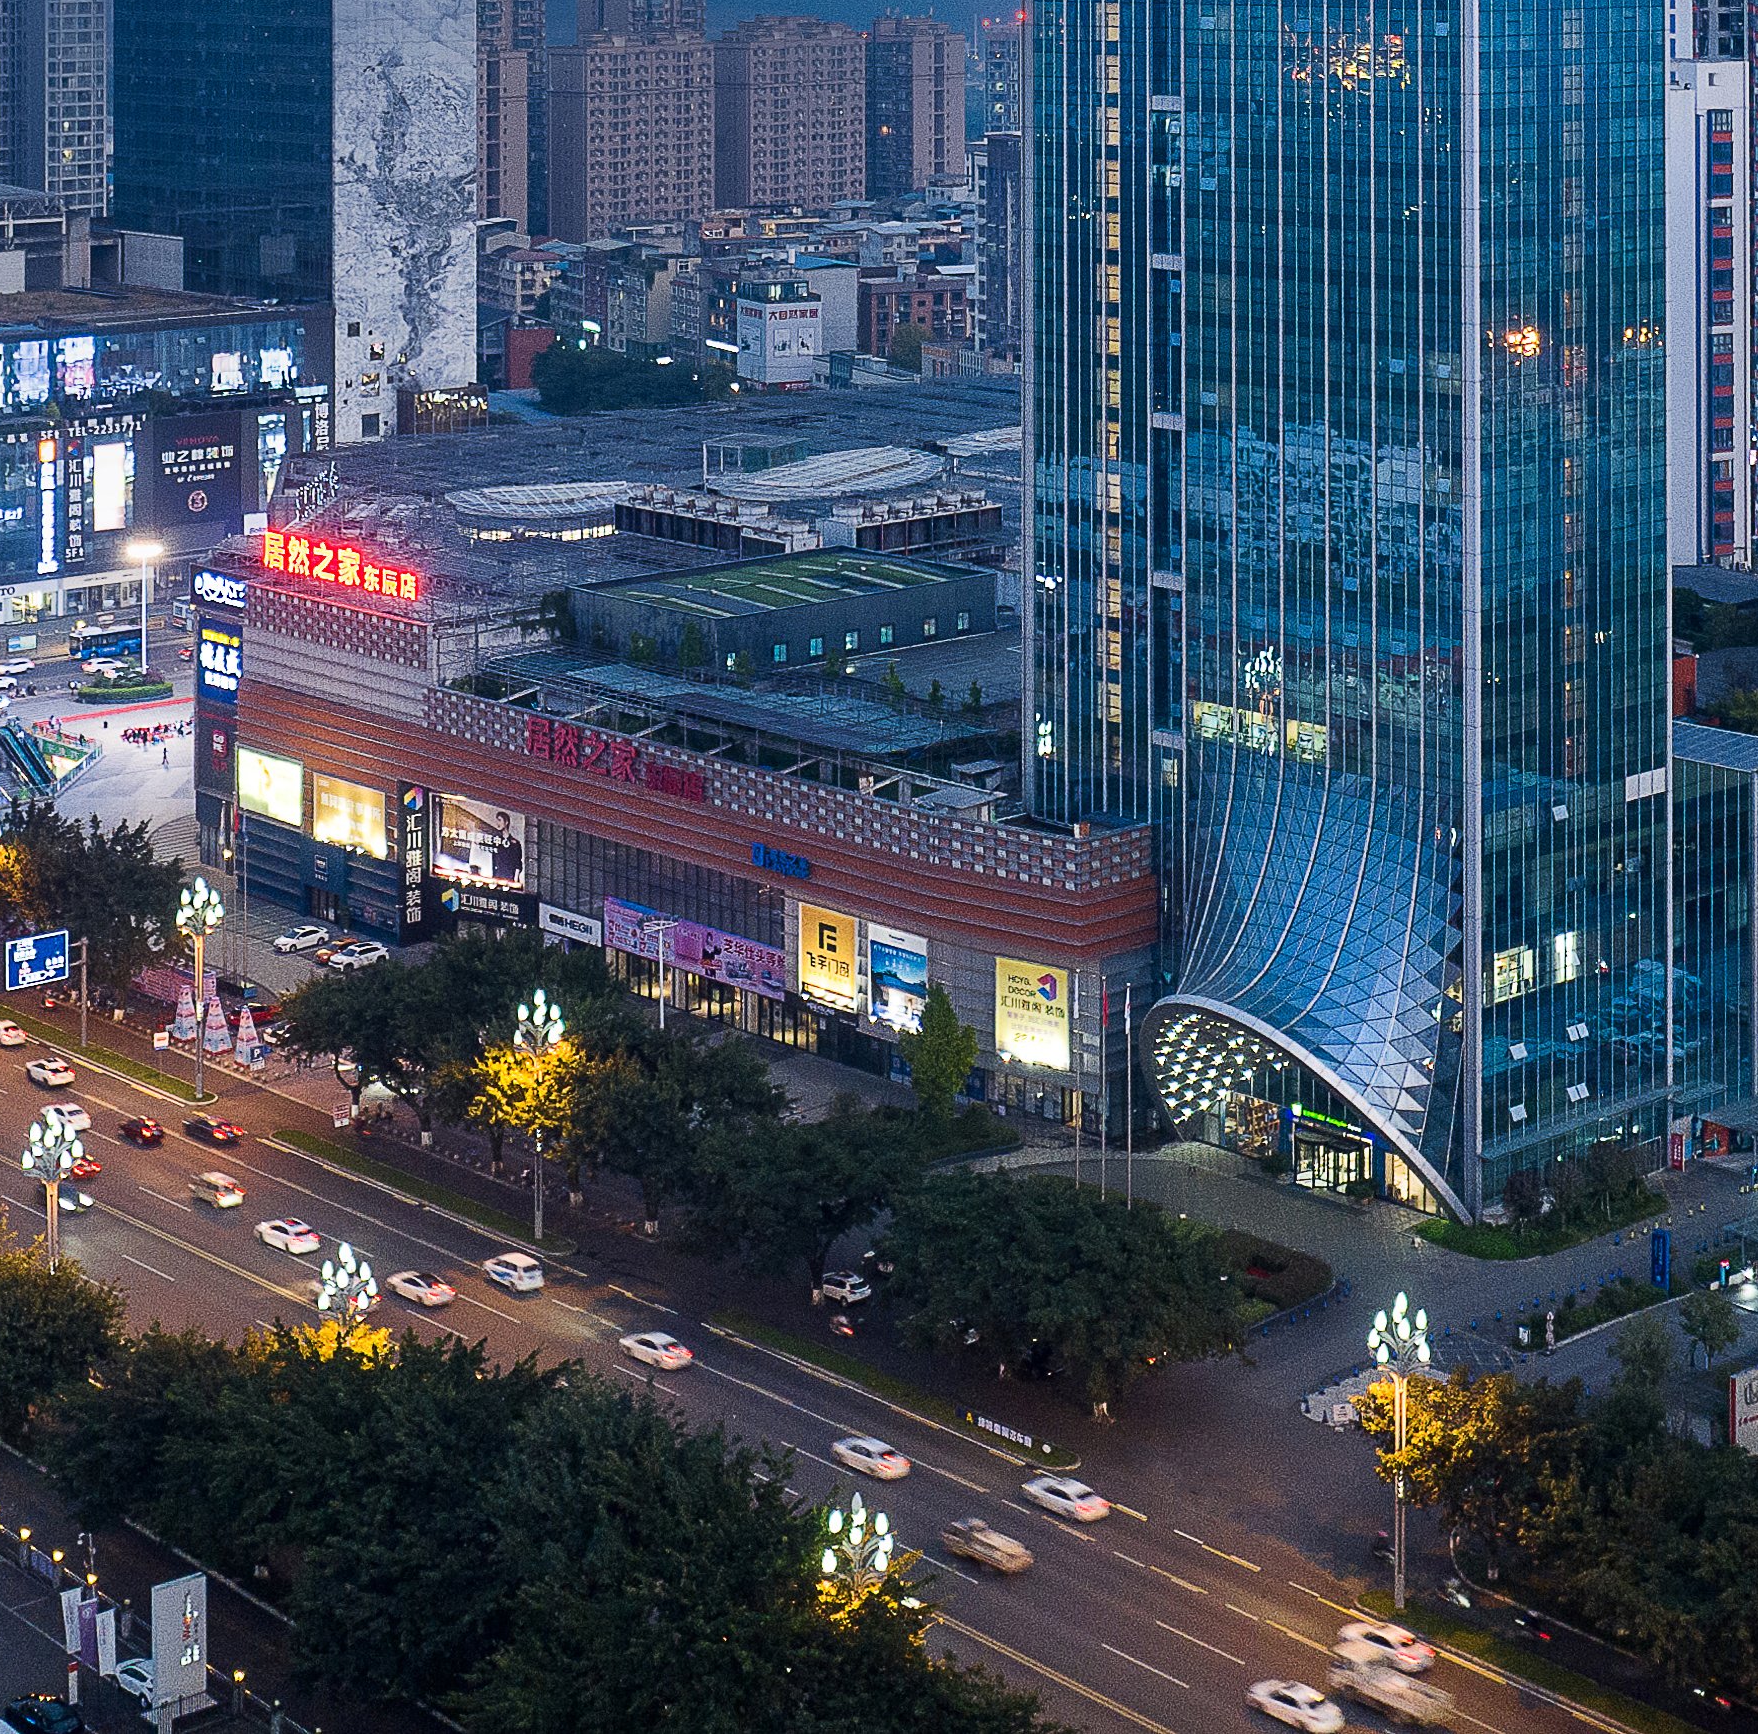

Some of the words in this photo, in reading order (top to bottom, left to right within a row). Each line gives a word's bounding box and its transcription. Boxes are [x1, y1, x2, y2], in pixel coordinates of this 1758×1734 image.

[263, 531, 361, 587] 居然之家
[363, 565, 416, 601] 东辰店
[527, 716, 637, 784] 居然之家
